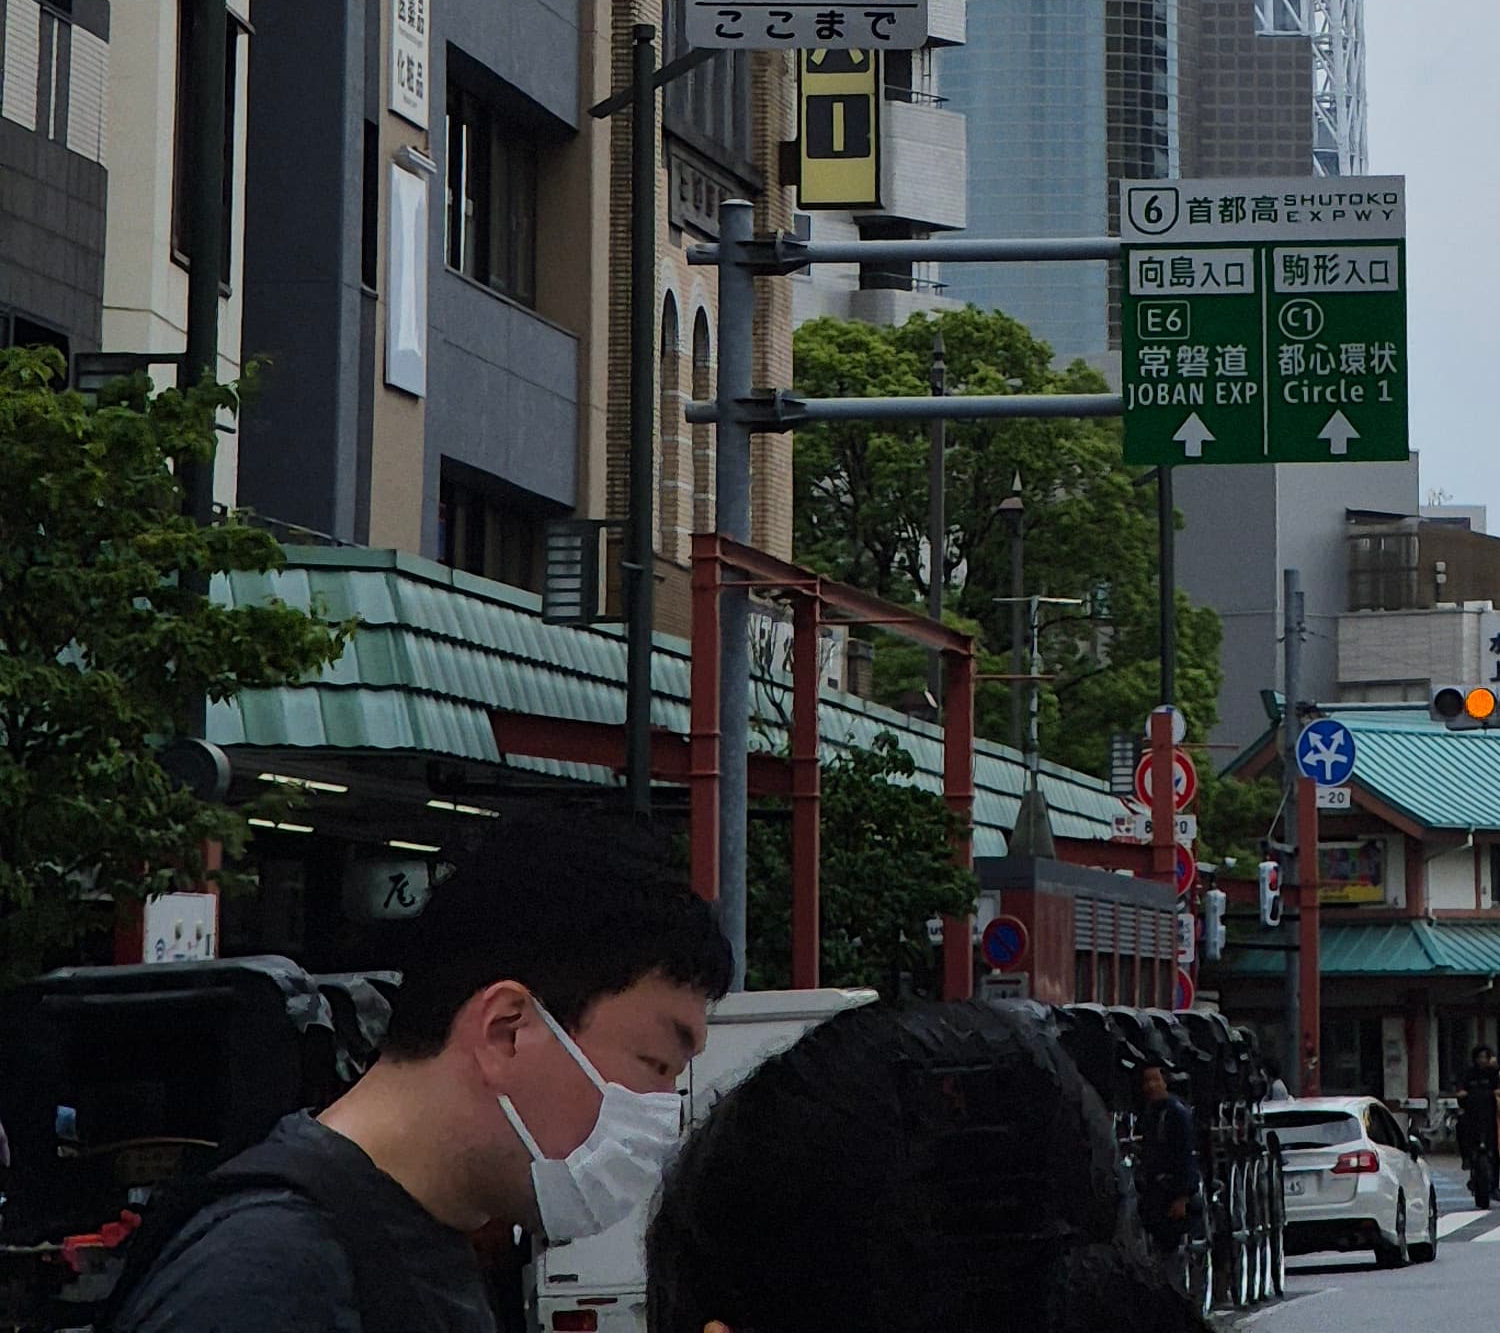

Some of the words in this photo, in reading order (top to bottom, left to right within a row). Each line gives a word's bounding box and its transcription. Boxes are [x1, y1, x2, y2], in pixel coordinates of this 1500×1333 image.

[715, 10, 897, 41] ここまで
[1143, 194, 1164, 224] 6
[1186, 195, 1279, 225] 首都高
[1284, 191, 1399, 206] SHUTOKO
[1286, 209, 1396, 223] EXPWY
[1138, 255, 1246, 290] 向島入口
[1282, 253, 1390, 287] 駒形入口
[1147, 308, 1183, 332] E6
[1287, 306, 1314, 331] C1
[1138, 344, 1249, 379] 常磐道
[1278, 341, 1398, 377] 都心環状
[1127, 383, 1205, 411] JOBAN
[1215, 383, 1258, 405] EXP
[1283, 380, 1364, 404] Circle
[1377, 380, 1393, 402] 1
